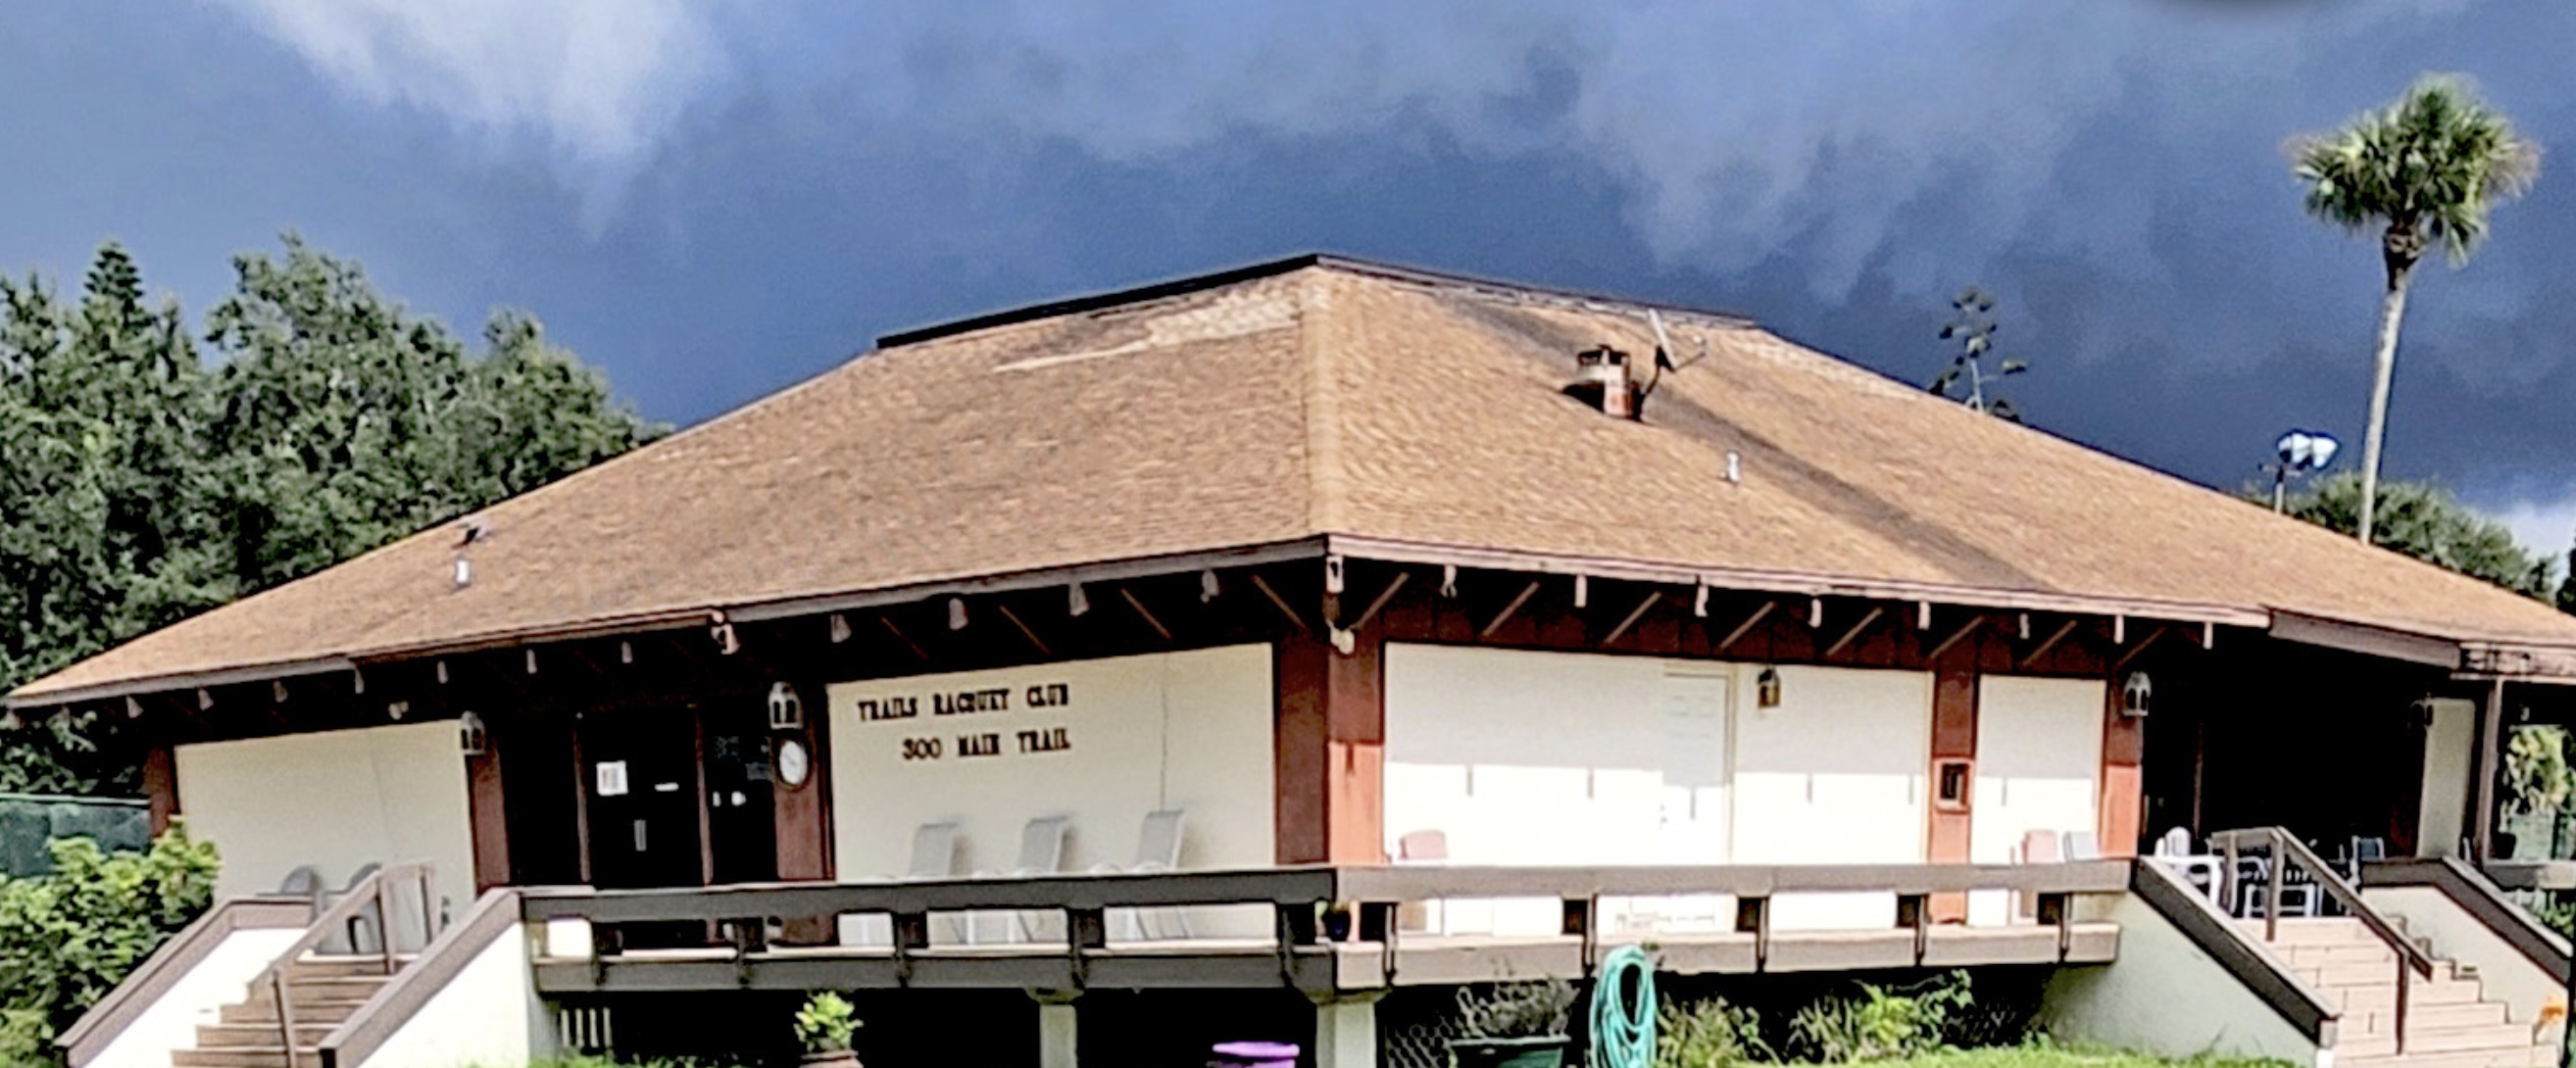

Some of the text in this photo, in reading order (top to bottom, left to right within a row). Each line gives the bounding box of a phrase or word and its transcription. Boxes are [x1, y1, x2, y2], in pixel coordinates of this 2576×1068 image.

[858, 698, 917, 721] TRAILS
[1026, 684, 1068, 706] CLUB
[902, 728, 1071, 760] 300 MAIN TRAIL
